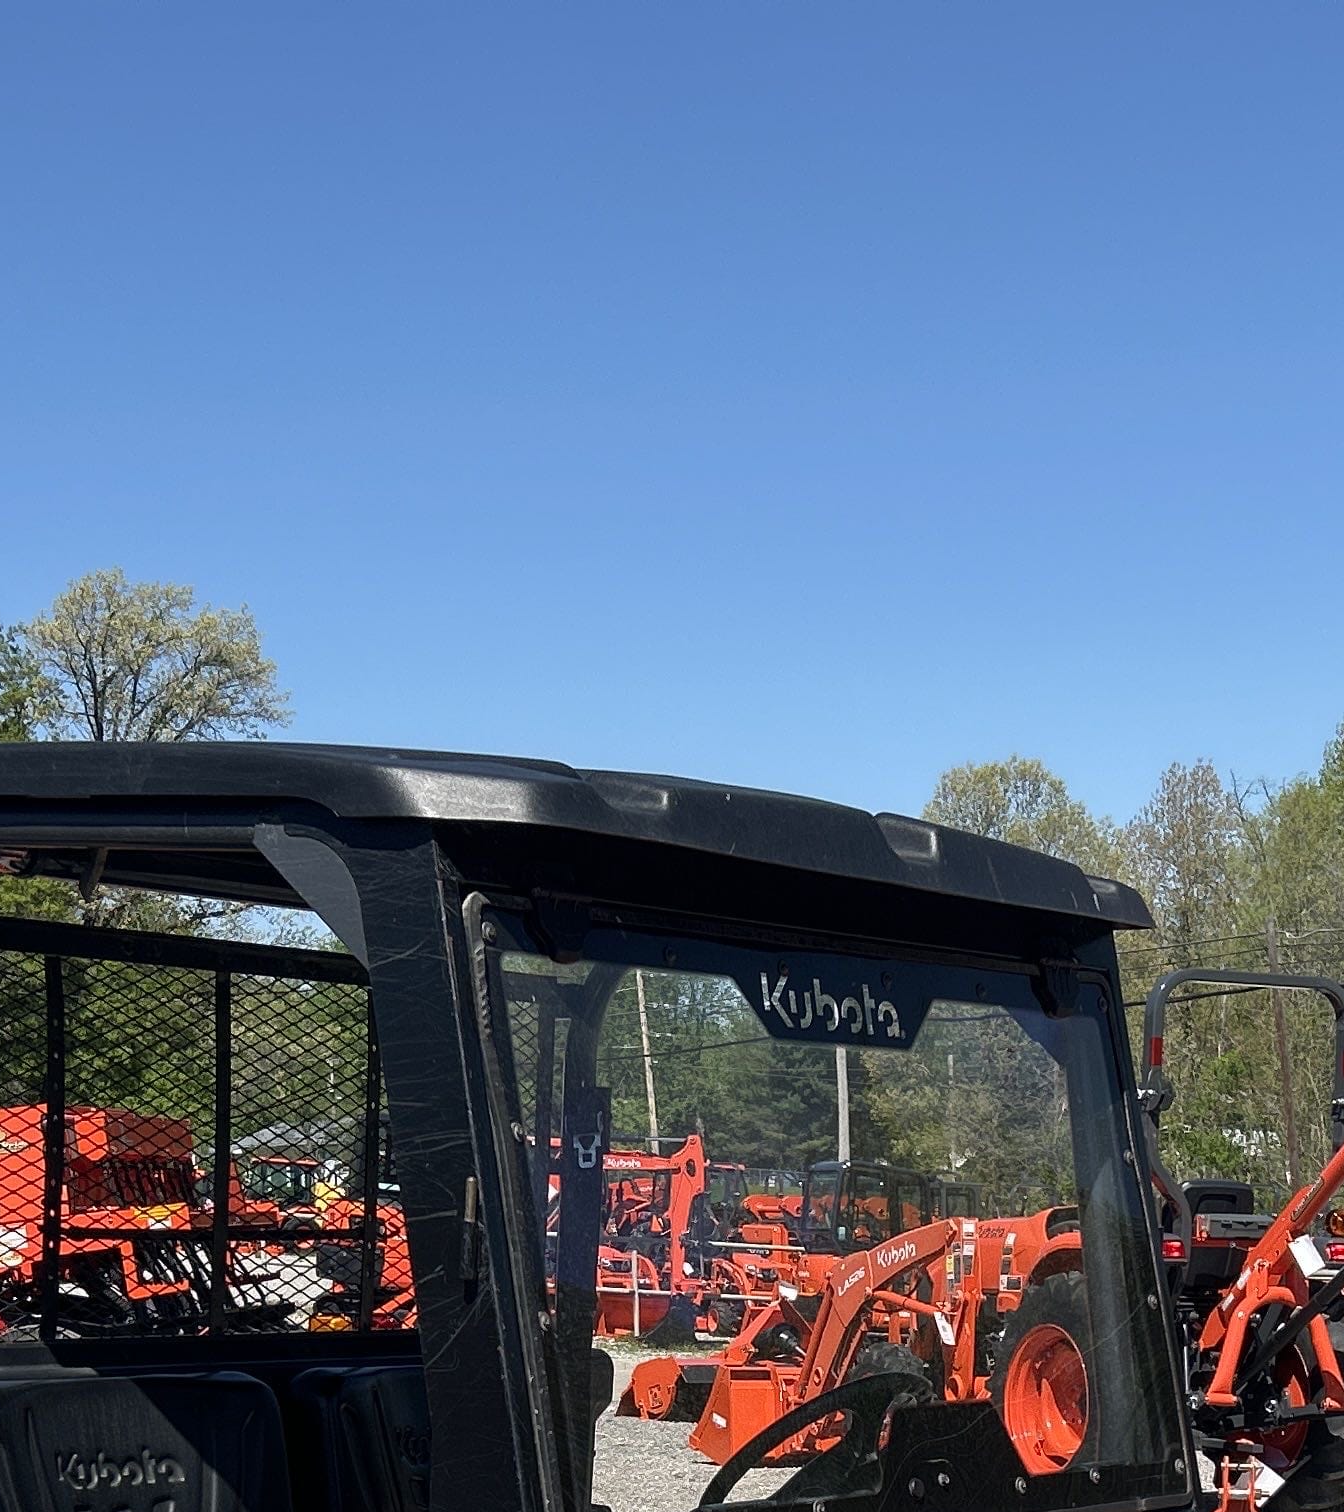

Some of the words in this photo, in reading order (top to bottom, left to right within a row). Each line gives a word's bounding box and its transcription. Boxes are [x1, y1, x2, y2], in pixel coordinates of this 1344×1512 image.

[759, 971, 902, 1039] Kubota
[877, 1241, 916, 1268] Kubota
[57, 1449, 185, 1490] Kubota
